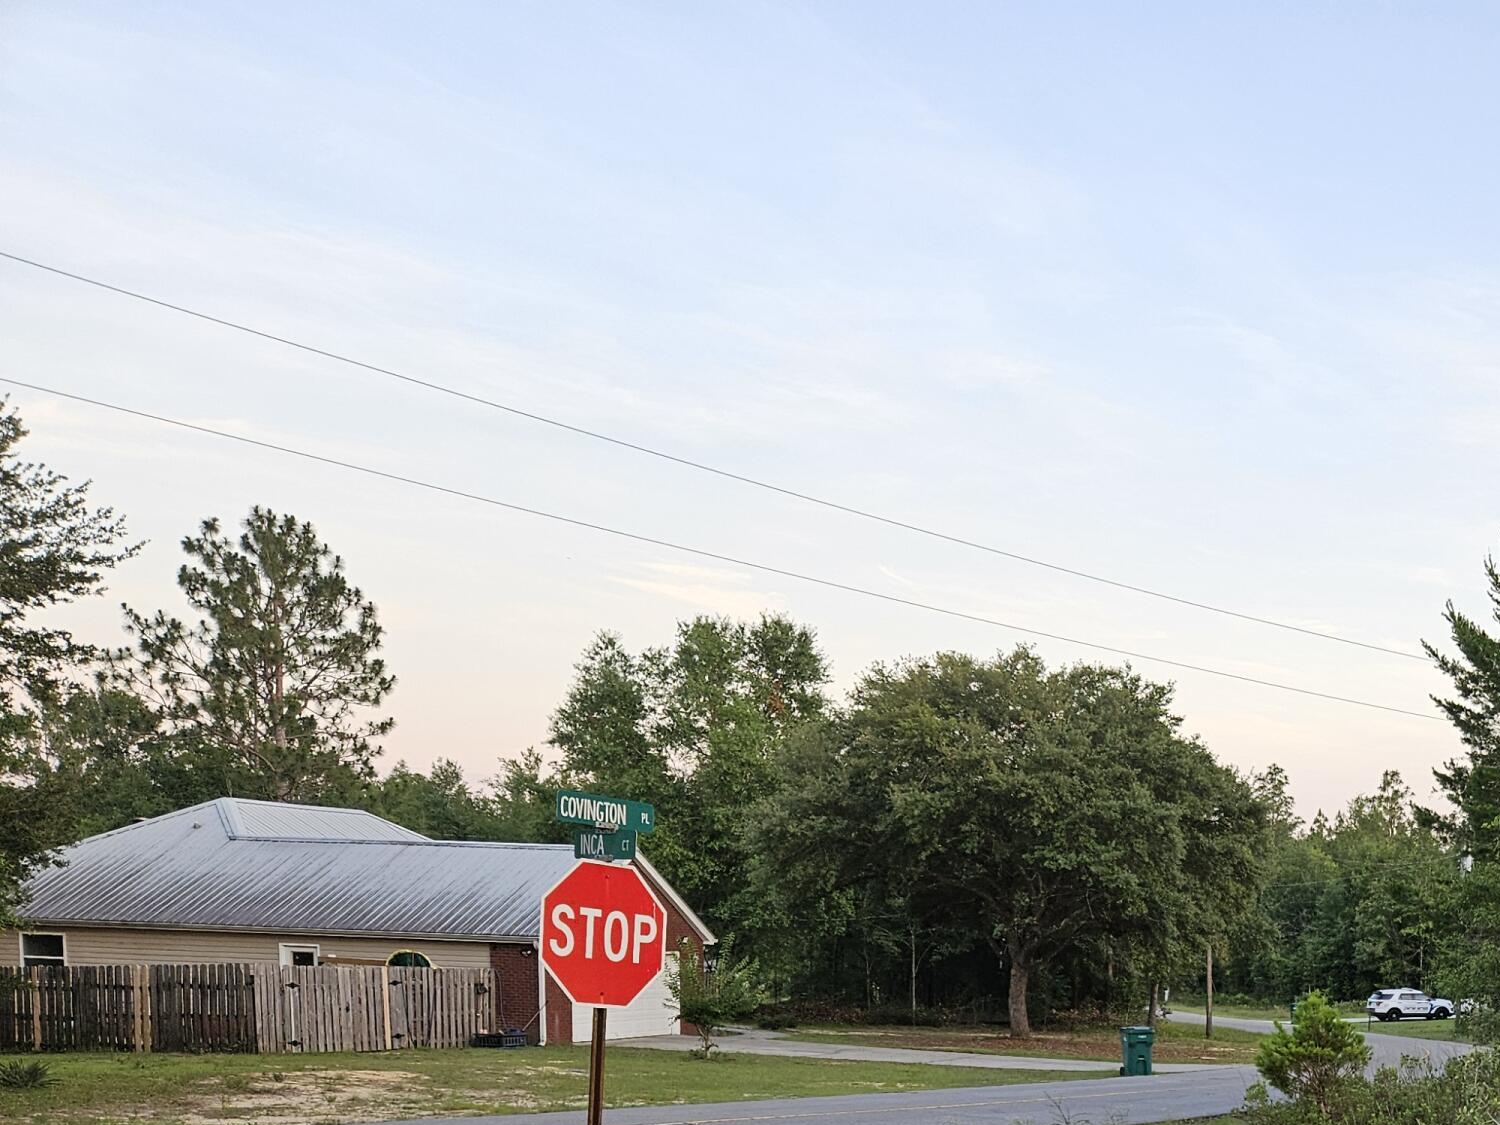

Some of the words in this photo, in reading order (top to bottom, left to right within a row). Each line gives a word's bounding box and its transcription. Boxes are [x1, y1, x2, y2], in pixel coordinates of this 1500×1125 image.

[560, 795, 627, 826] COVINGTON
[641, 812, 650, 825] PL
[580, 833, 605, 855] INCA
[621, 839, 630, 851] CT
[549, 903, 658, 964] STOP
